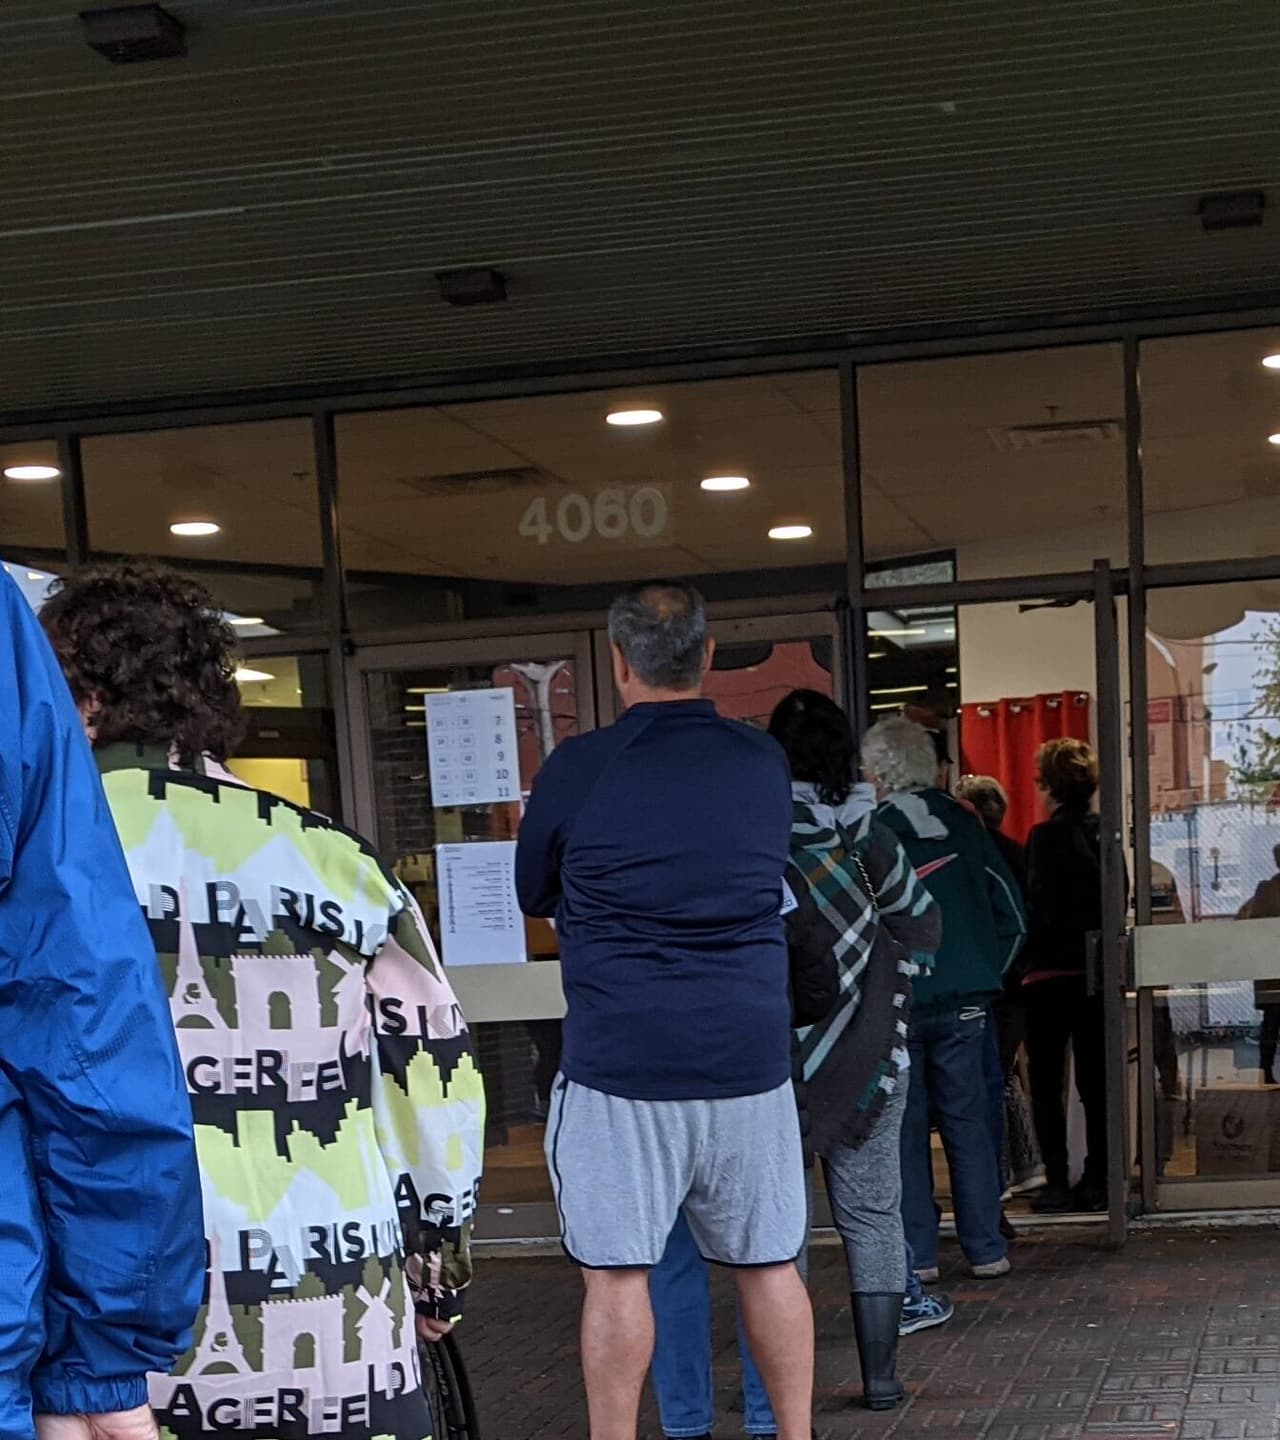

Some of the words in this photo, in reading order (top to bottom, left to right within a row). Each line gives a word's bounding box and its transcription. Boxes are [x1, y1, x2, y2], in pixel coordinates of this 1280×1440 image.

[519, 487, 667, 544] 4060
[496, 769, 509, 780] 10
[498, 787, 510, 797] 11
